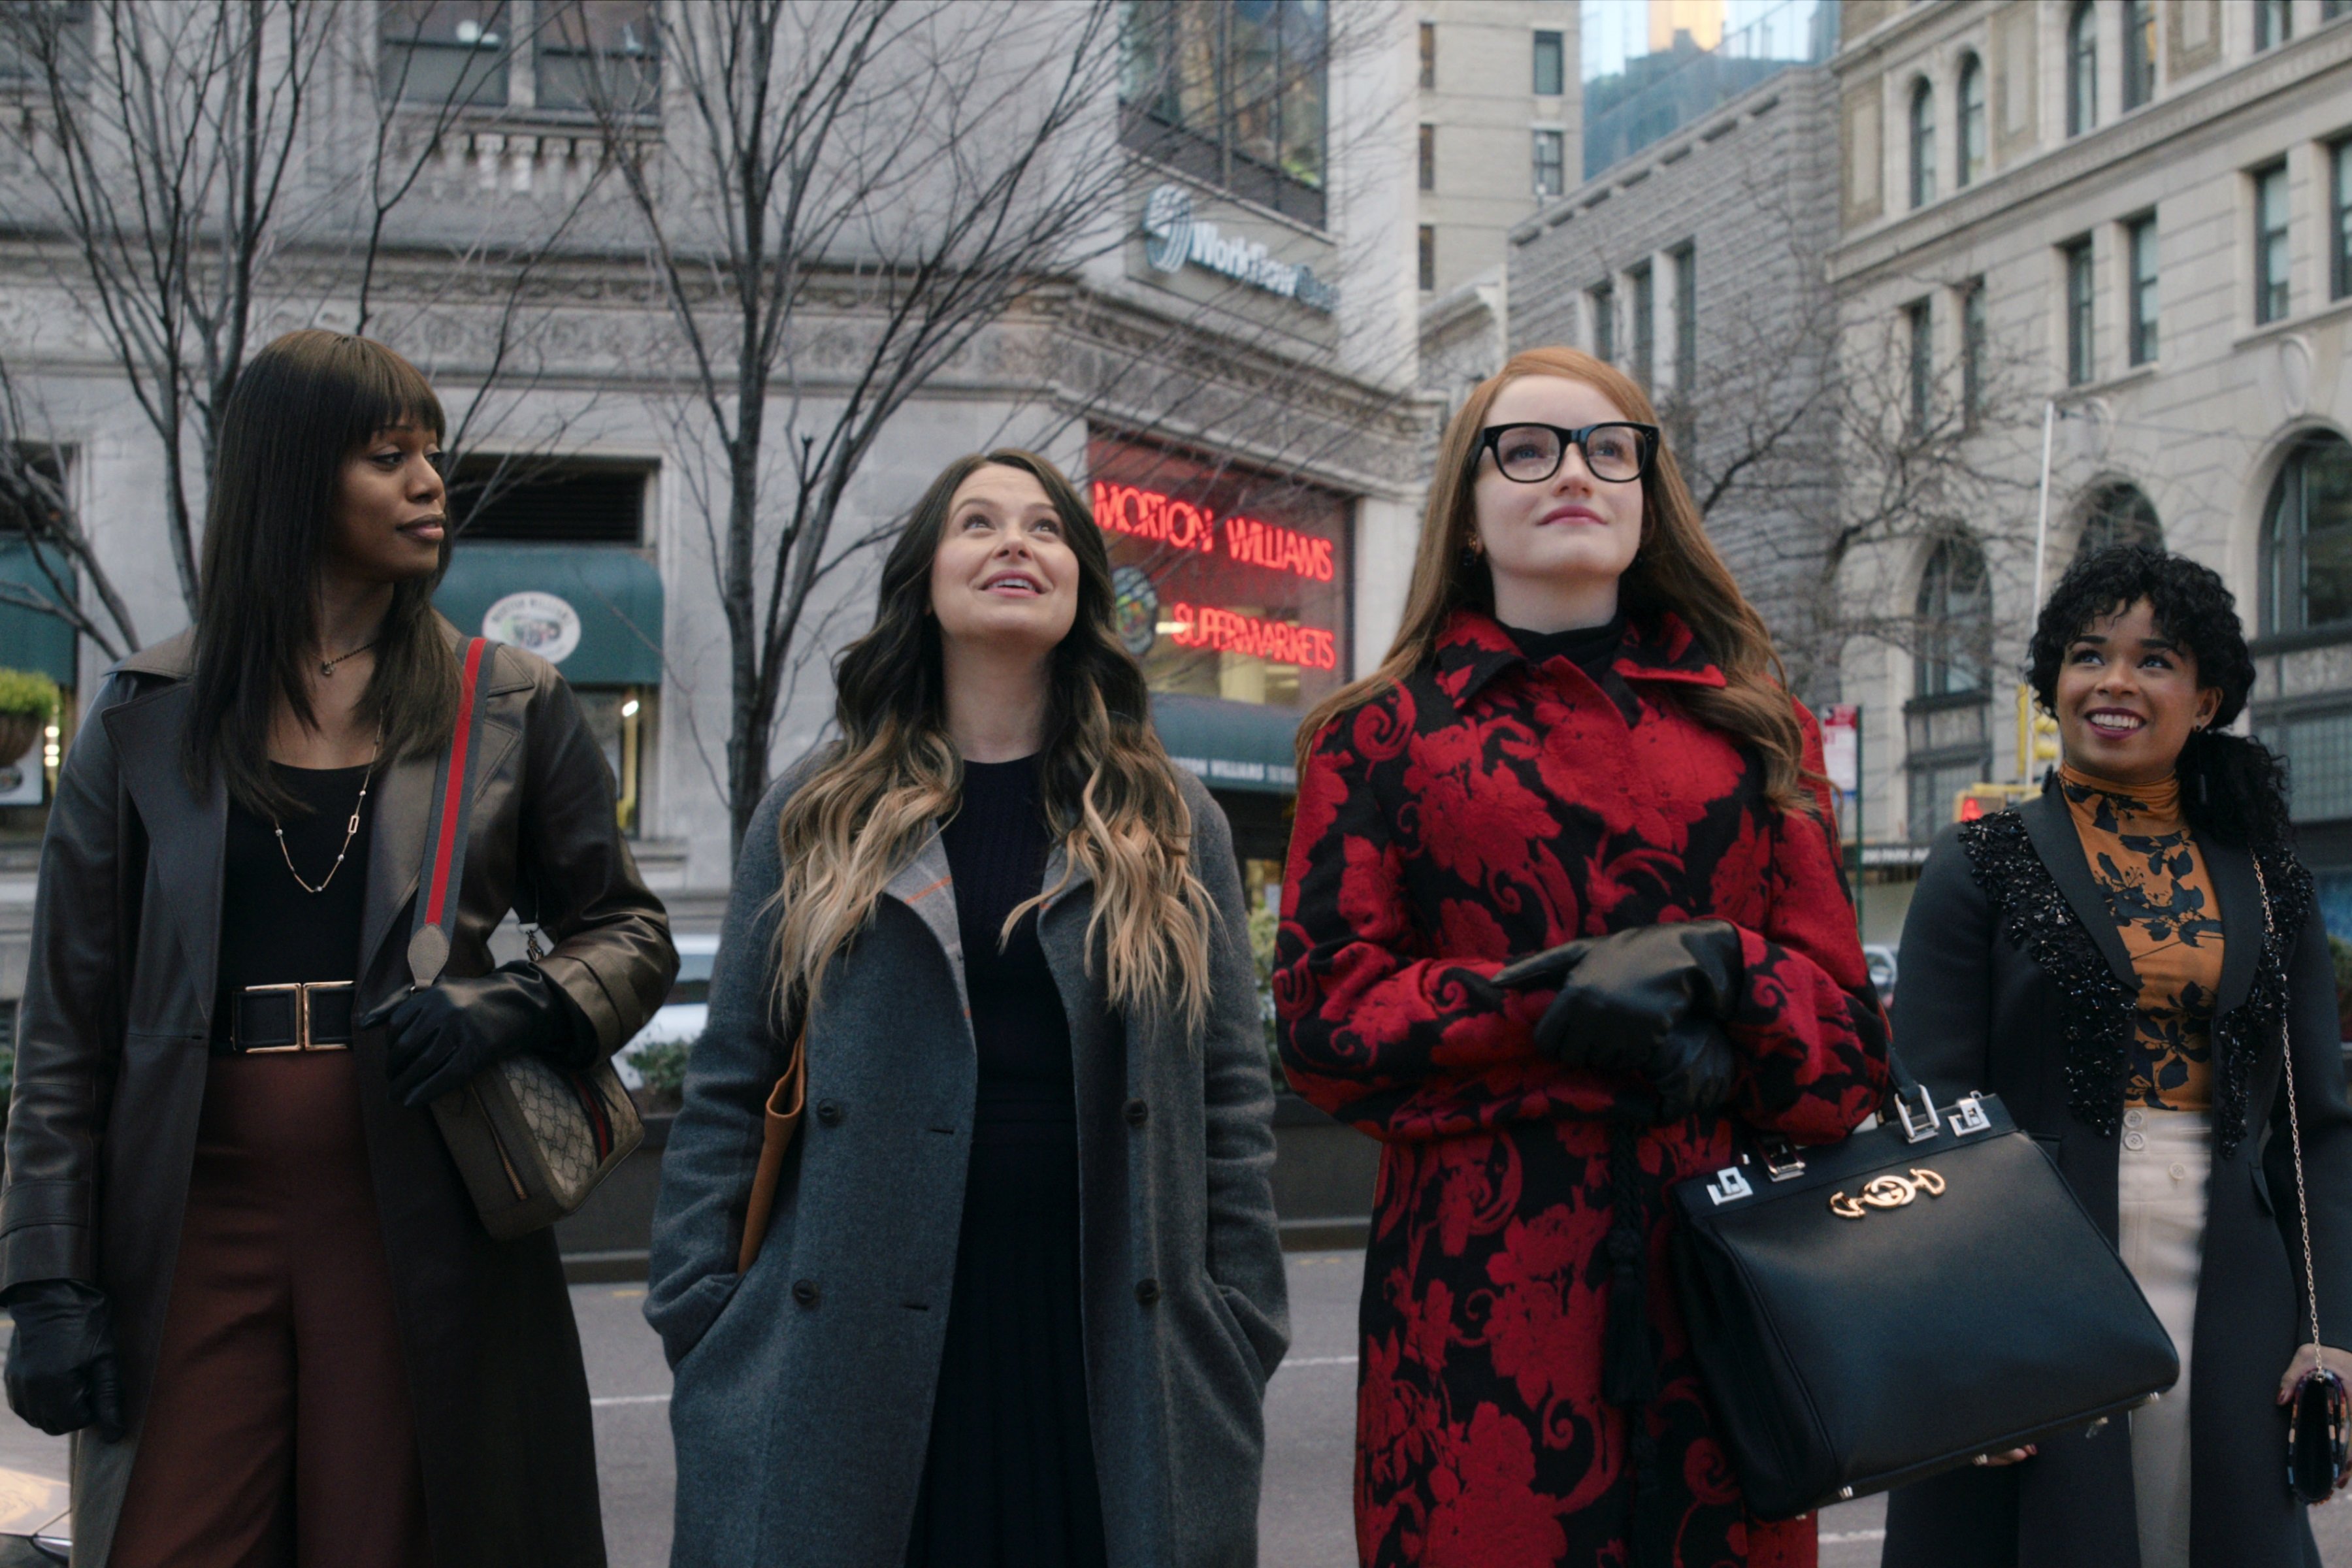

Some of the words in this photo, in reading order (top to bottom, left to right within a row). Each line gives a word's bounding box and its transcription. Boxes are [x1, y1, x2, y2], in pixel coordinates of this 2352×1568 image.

[1093, 482, 1213, 552] MORTON
[1226, 518, 1333, 582] WILLIAMS
[1171, 602, 1336, 670] SUPERMARKETS
